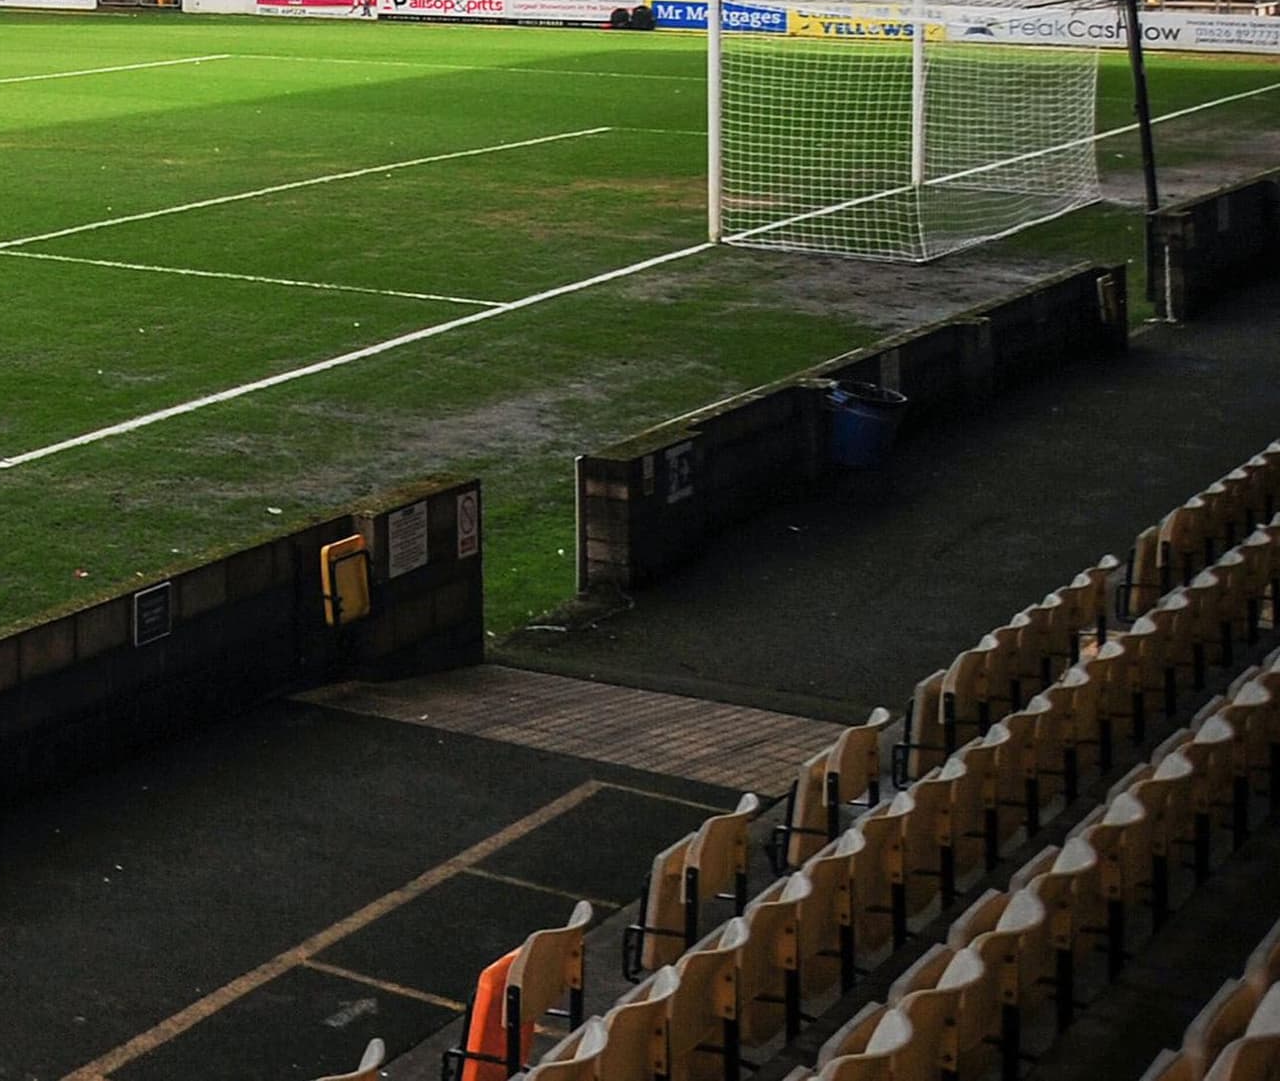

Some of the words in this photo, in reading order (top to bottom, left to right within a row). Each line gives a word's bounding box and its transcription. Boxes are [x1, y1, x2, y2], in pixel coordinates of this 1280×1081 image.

[657, 5, 683, 19] Mr
[686, 6, 781, 27] Mtgages
[1009, 18, 1180, 41] PeakCashlow
